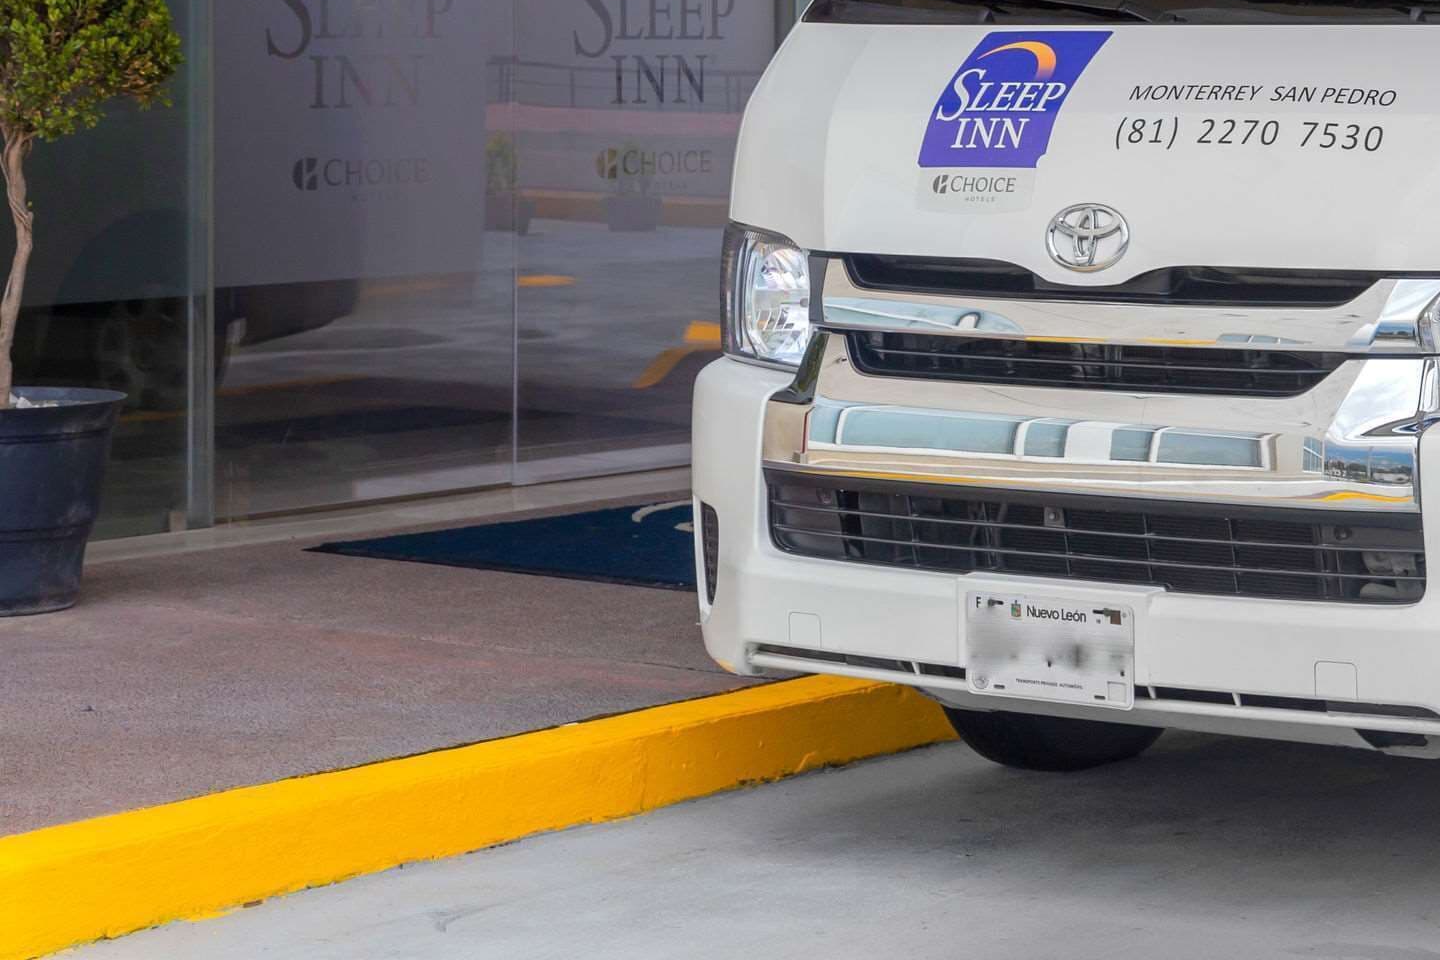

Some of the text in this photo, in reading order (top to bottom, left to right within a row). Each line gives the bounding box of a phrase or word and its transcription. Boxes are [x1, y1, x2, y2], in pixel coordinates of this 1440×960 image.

[309, 55, 422, 109] INN
[611, 55, 709, 104] INN
[936, 68, 1066, 121] SLEEP
[1129, 85, 1397, 107] MONTERREY SAN PEDRO
[950, 118, 1030, 149] INN
[1115, 116, 1384, 152] (81) 2270 7530
[323, 158, 432, 186] CHOICE
[623, 150, 711, 176] CHOICE
[950, 175, 1017, 193] CHOICE
[1026, 605, 1087, 623] Nuevo León
